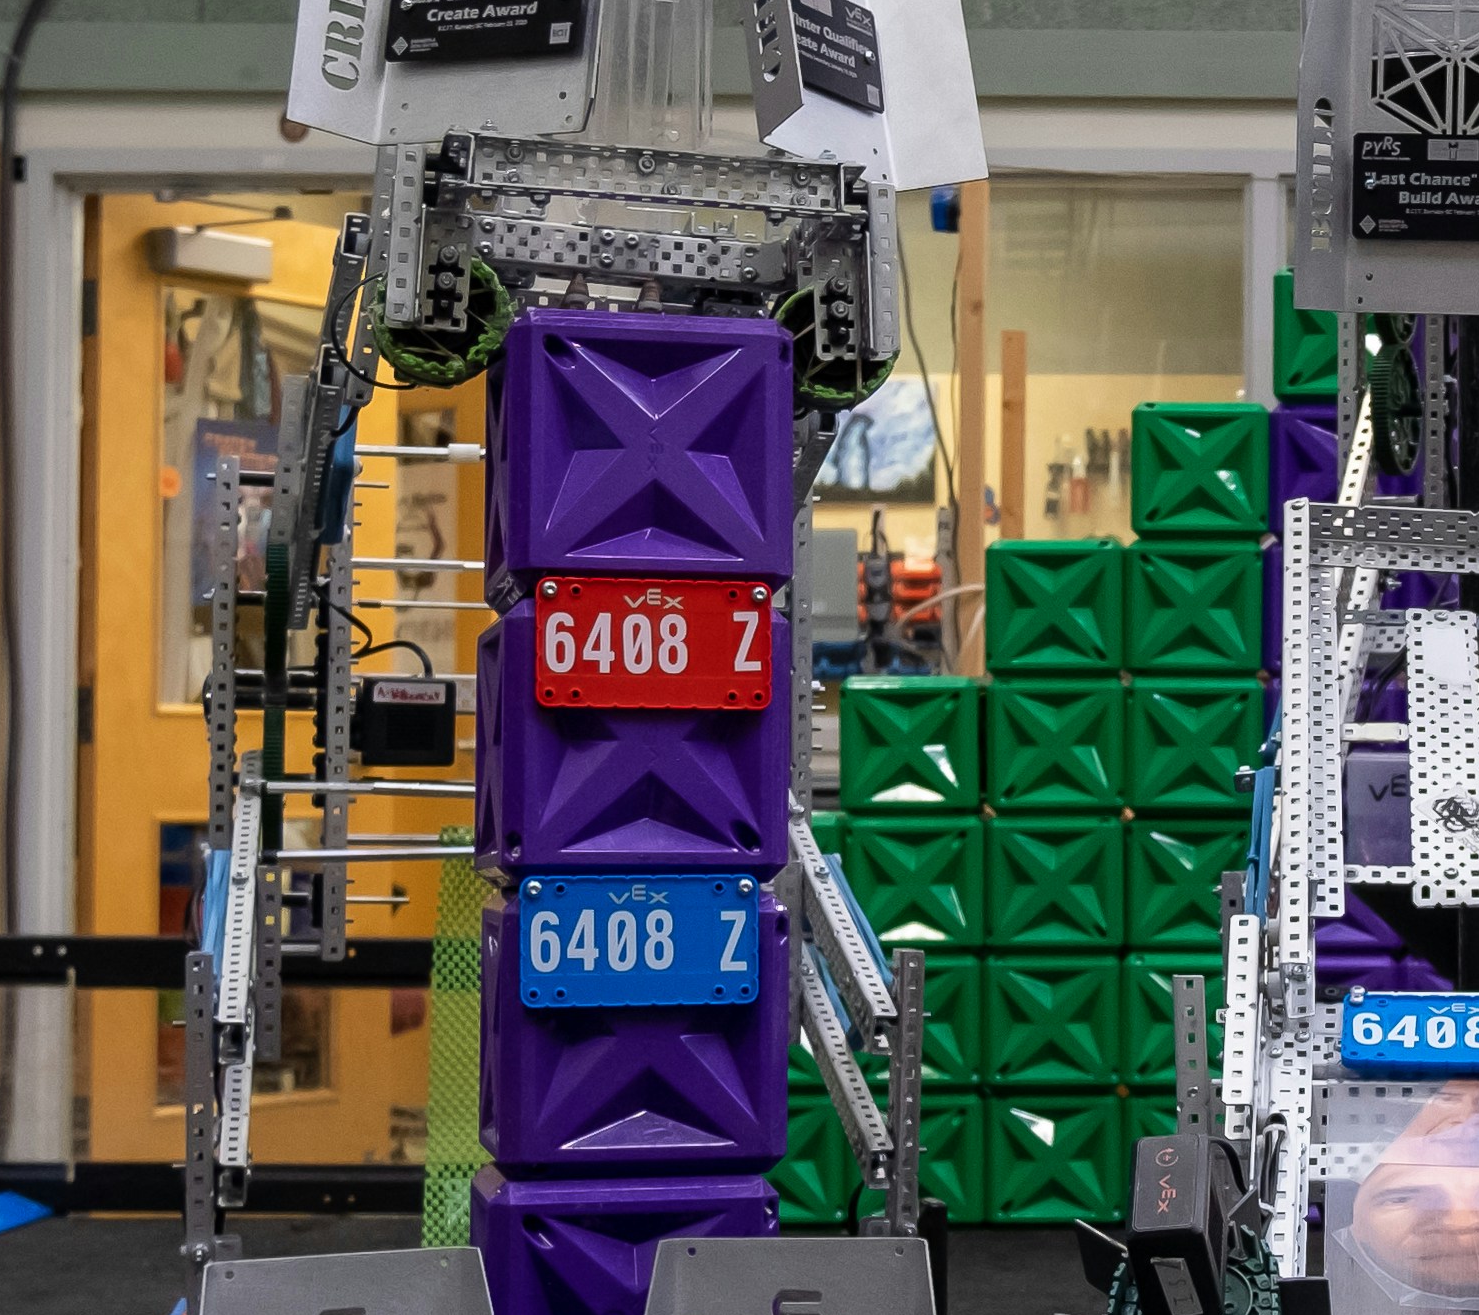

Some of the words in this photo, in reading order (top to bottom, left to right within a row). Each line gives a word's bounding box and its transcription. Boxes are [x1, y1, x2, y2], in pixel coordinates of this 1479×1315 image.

[427, 8, 480, 22] Create
[482, 2, 539, 18] Award
[795, 34, 819, 52] eate
[820, 43, 856, 68] Award
[823, 26, 873, 60] Qualifie
[1362, 136, 1401, 156] PYRS
[1409, 172, 1478, 187] Chance"
[1398, 191, 1442, 205] Build
[623, 588, 684, 609] VEX
[545, 612, 688, 674] 6408
[732, 611, 762, 672] Z
[608, 884, 670, 905] VEX
[530, 909, 674, 973] 6408
[719, 910, 748, 972] Z
[1158, 1174, 1177, 1214] VEX
